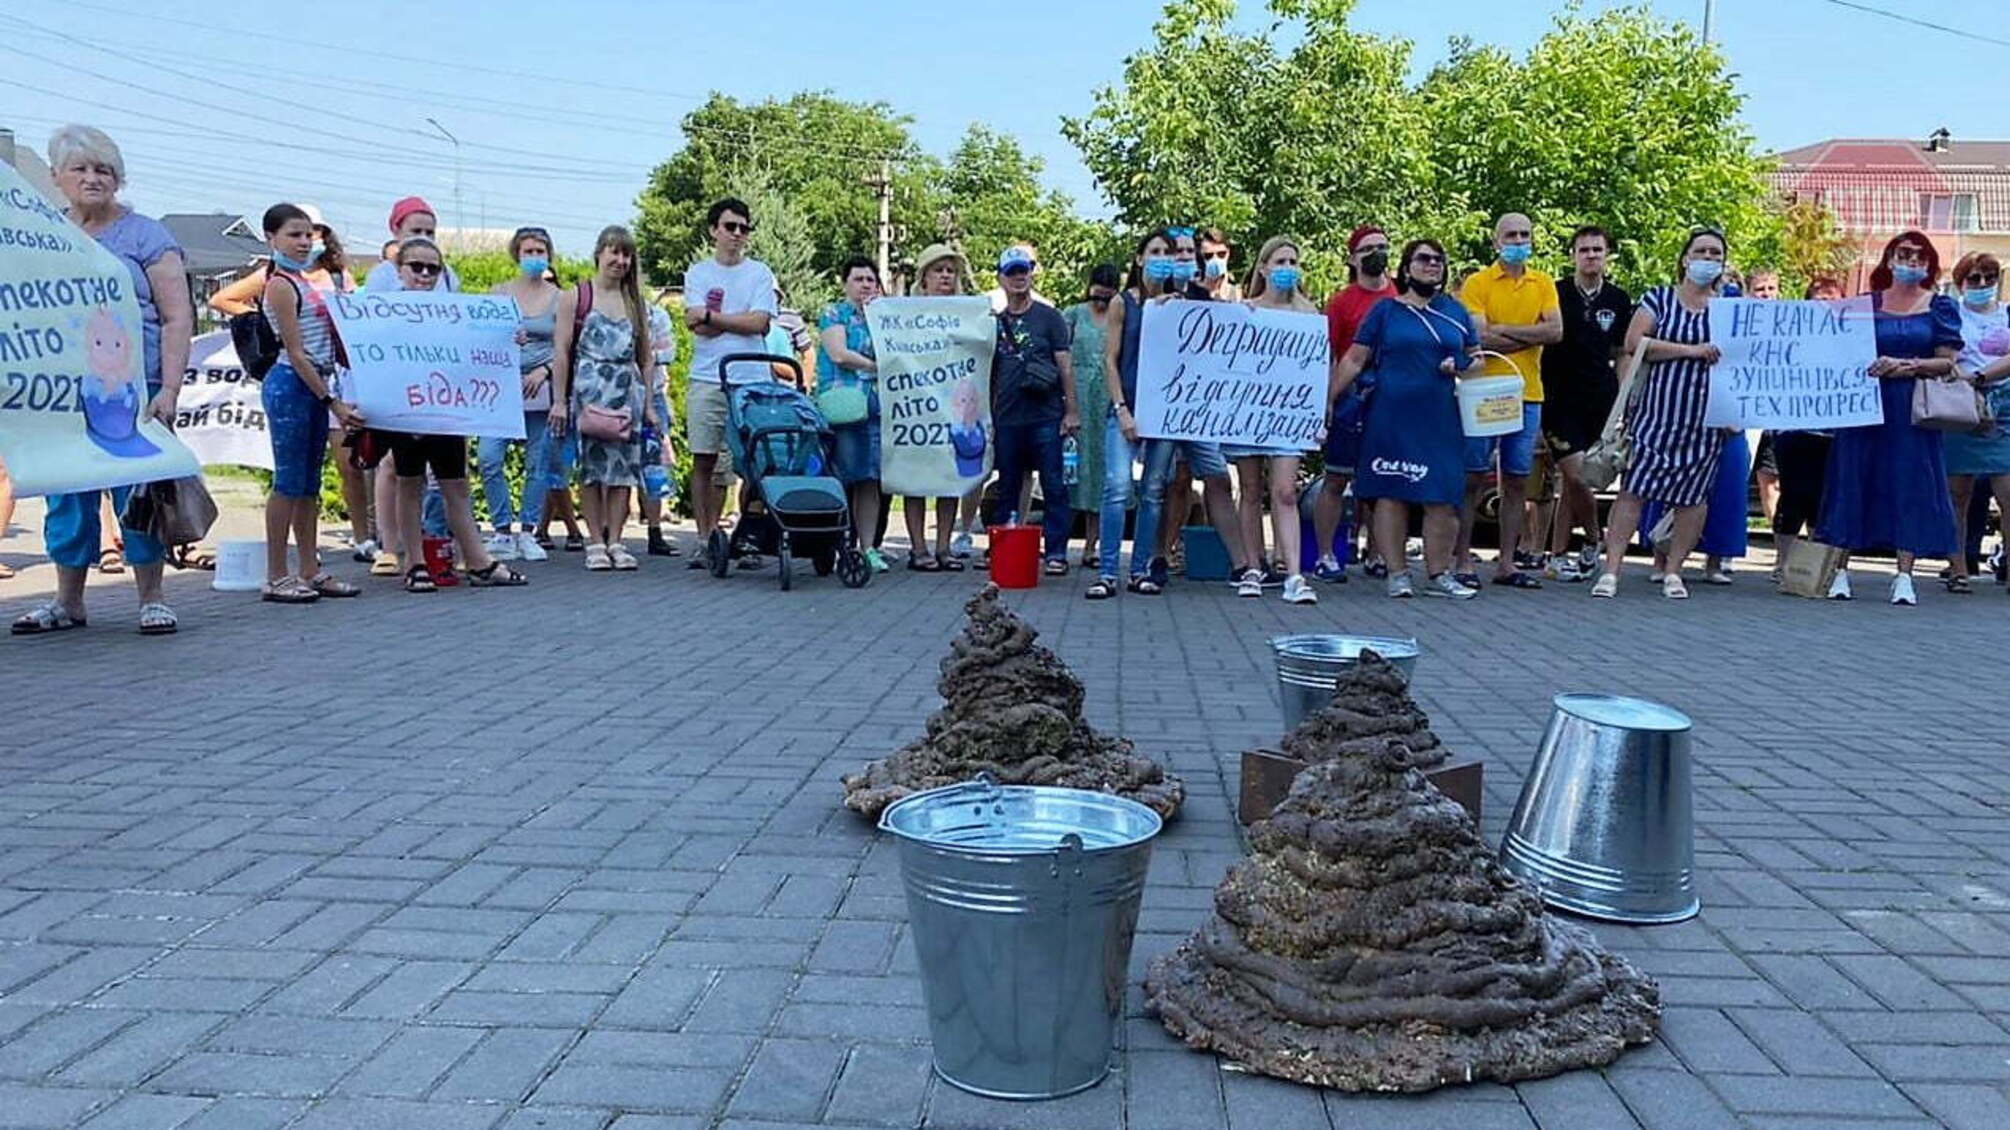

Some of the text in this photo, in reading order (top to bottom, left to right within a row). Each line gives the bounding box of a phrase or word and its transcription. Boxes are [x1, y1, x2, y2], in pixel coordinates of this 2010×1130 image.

[0, 277, 122, 311] пекотне
[1731, 303, 1764, 338] НЕ
[1749, 340, 1801, 367] КНС
[2, 373, 84, 412] 2021
[891, 396, 940, 420] літо
[892, 422, 952, 446] 2021
